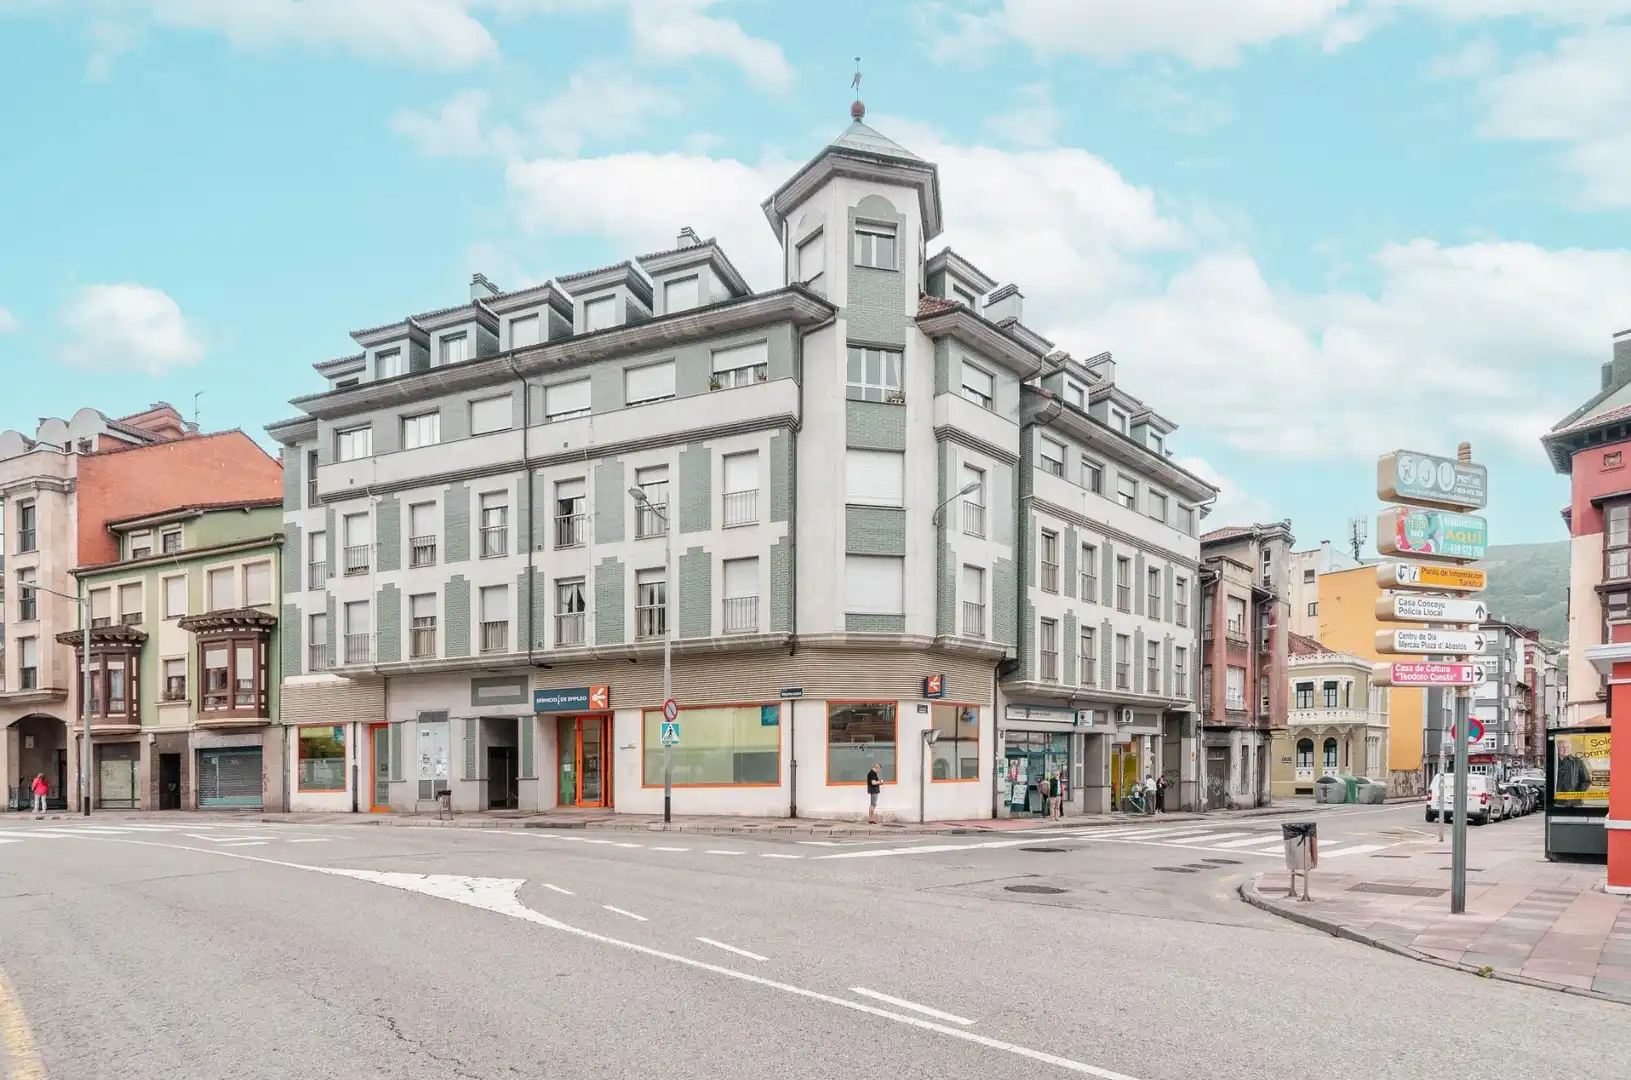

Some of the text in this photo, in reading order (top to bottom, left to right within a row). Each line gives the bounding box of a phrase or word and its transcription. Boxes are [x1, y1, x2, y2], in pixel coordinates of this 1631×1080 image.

[1421, 566, 1440, 576] Punto
[1398, 598, 1446, 609] Casa Conceyu
[1419, 633, 1426, 641] de
[1421, 641, 1437, 650] Plaza
[1445, 642, 1467, 651] Abastos
[1395, 664, 1451, 673] Casa de Cultura
